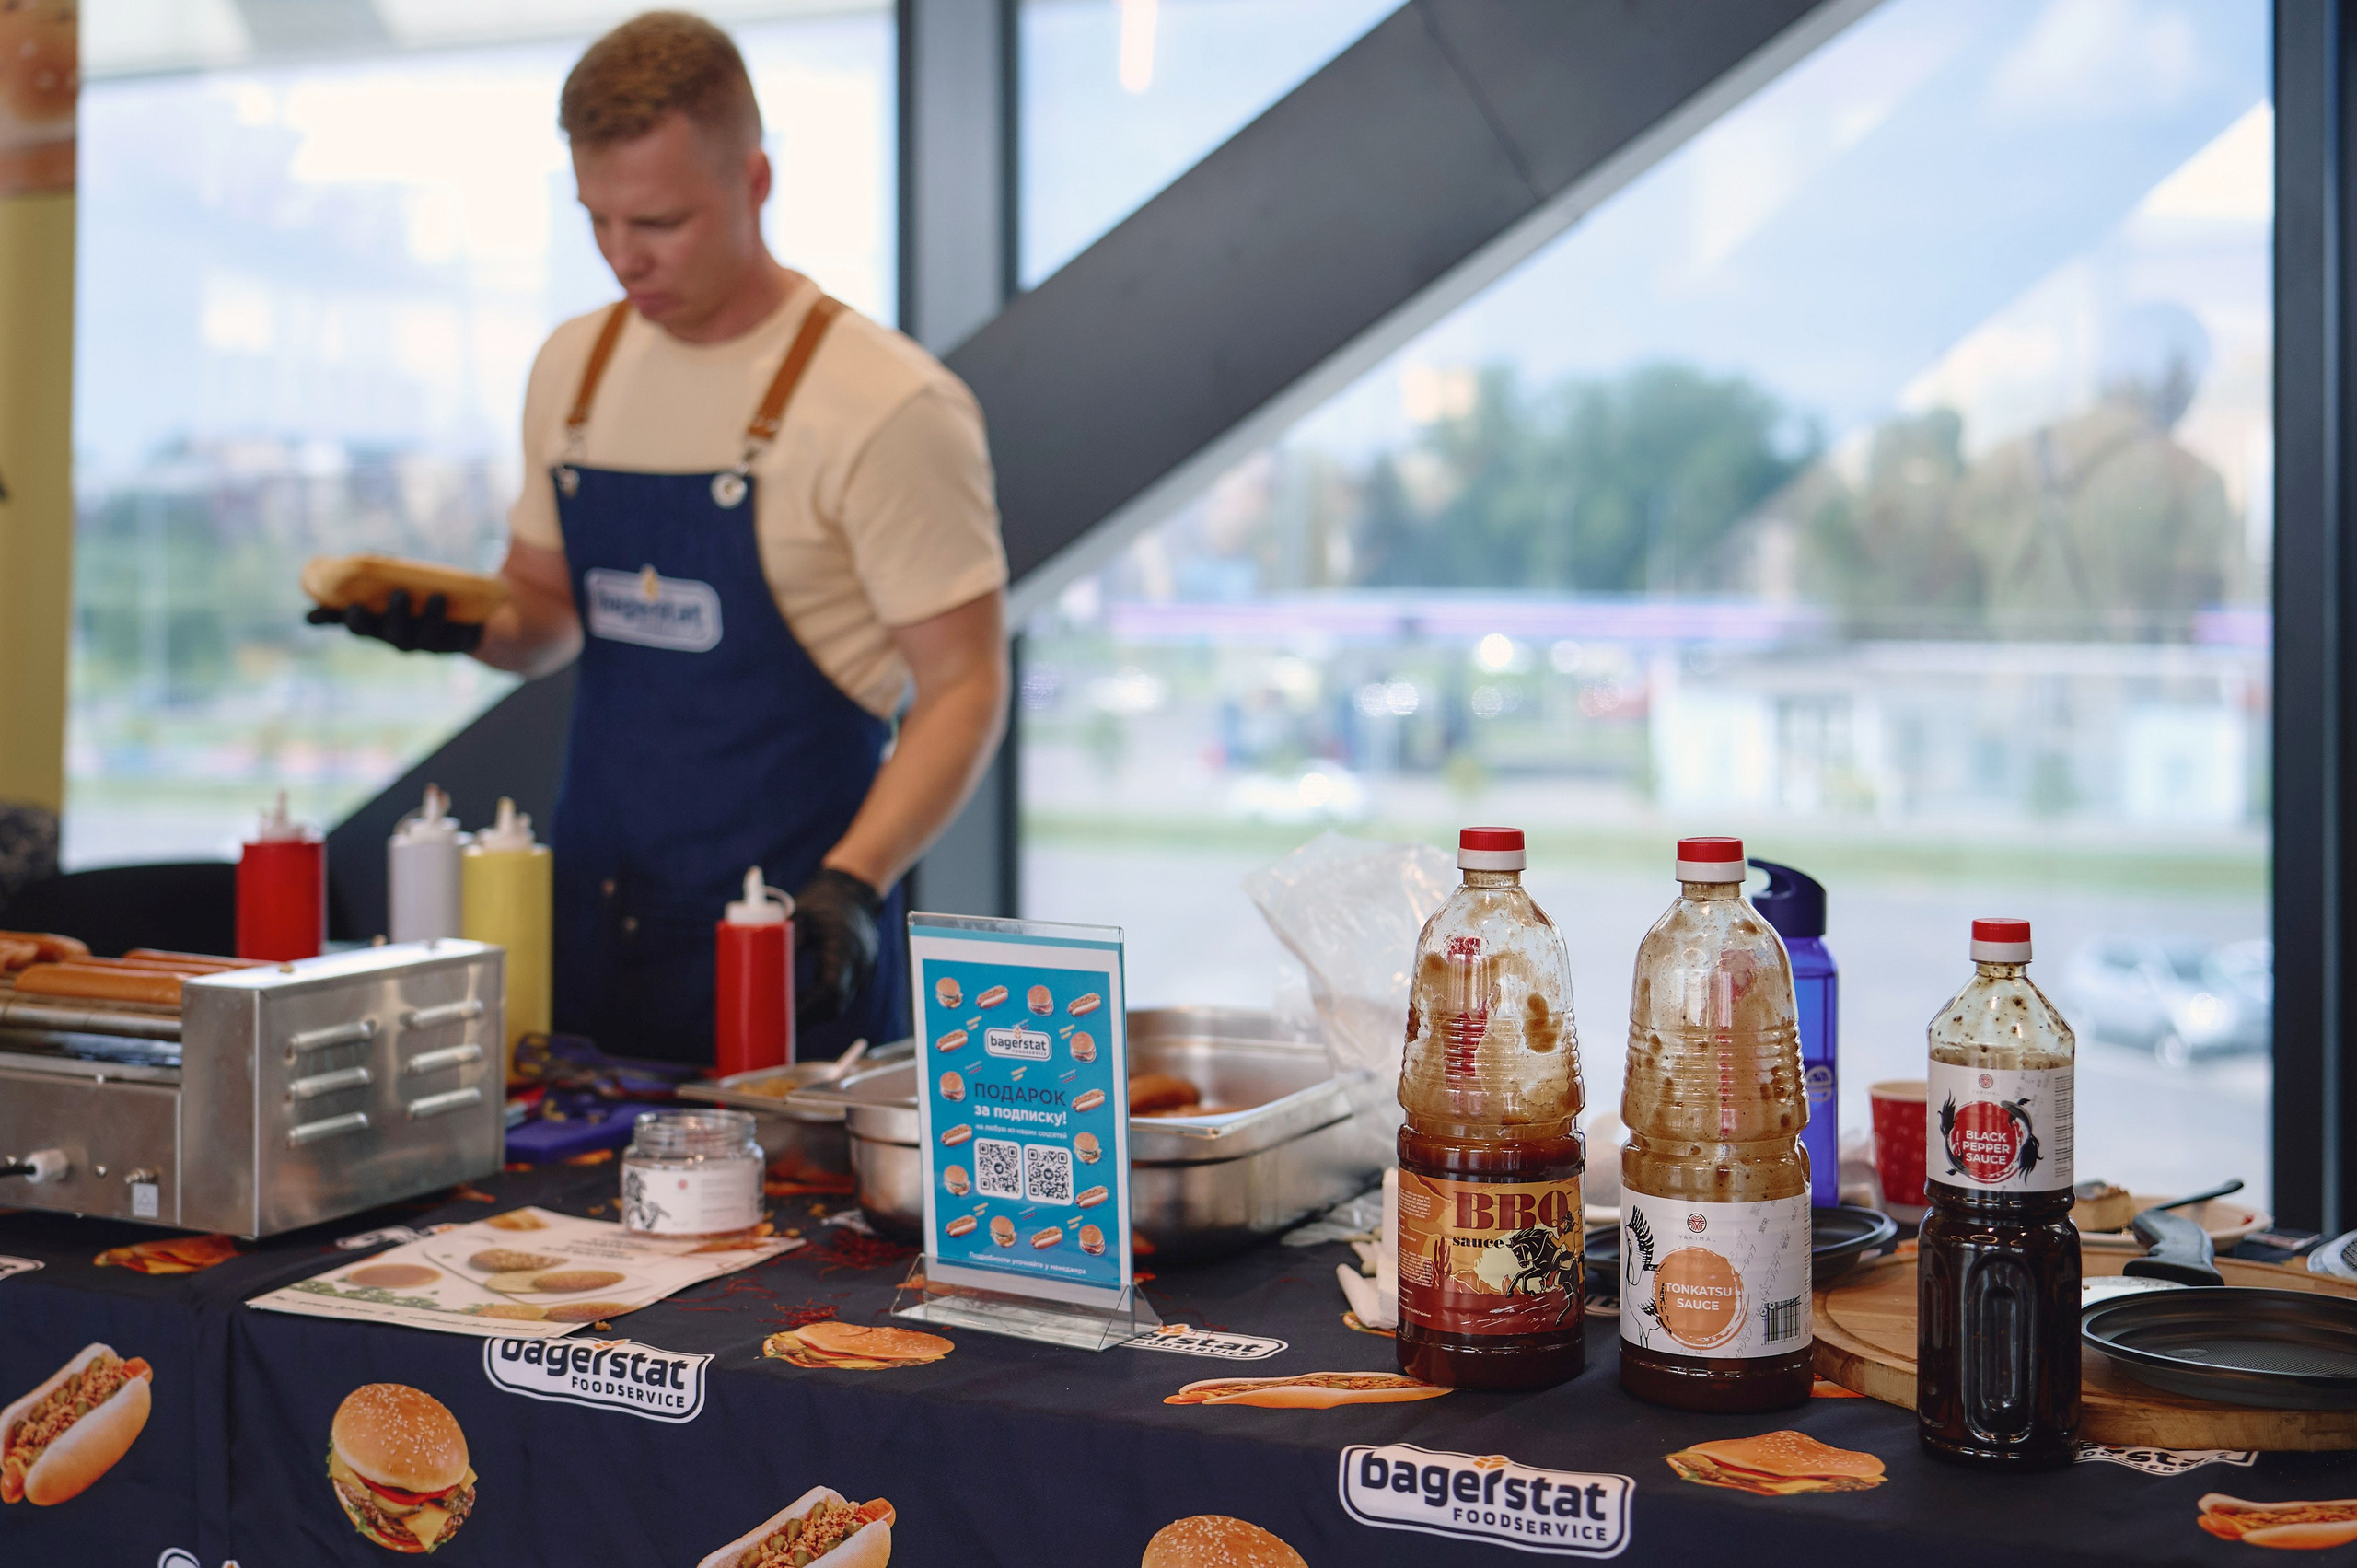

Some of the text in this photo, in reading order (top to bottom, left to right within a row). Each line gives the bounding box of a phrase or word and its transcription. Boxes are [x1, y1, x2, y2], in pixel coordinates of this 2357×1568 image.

[990, 1035, 1047, 1051] bagerstat
[974, 1082, 1066, 1106] ПОДАРОК
[974, 1105, 1068, 1127] за подписку!
[1965, 1130, 2007, 1143] BLACK
[1962, 1141, 2011, 1155] PEPPER
[1965, 1152, 2007, 1166] SAUCE
[1452, 1190, 1569, 1237] BBQ
[1452, 1237, 1505, 1249] sauce
[1678, 1235, 1716, 1243] YAKIMAL
[1665, 1282, 1733, 1297] TONKATSU
[1677, 1297, 1720, 1311] SAUCE
[1133, 1341, 1252, 1356] OODSERVICE
[500, 1338, 689, 1391] bagerstat
[571, 1376, 685, 1409] FOODSERVICE
[1360, 1451, 1608, 1522] bagerstat
[1453, 1507, 1608, 1542] FOODSERVICE
